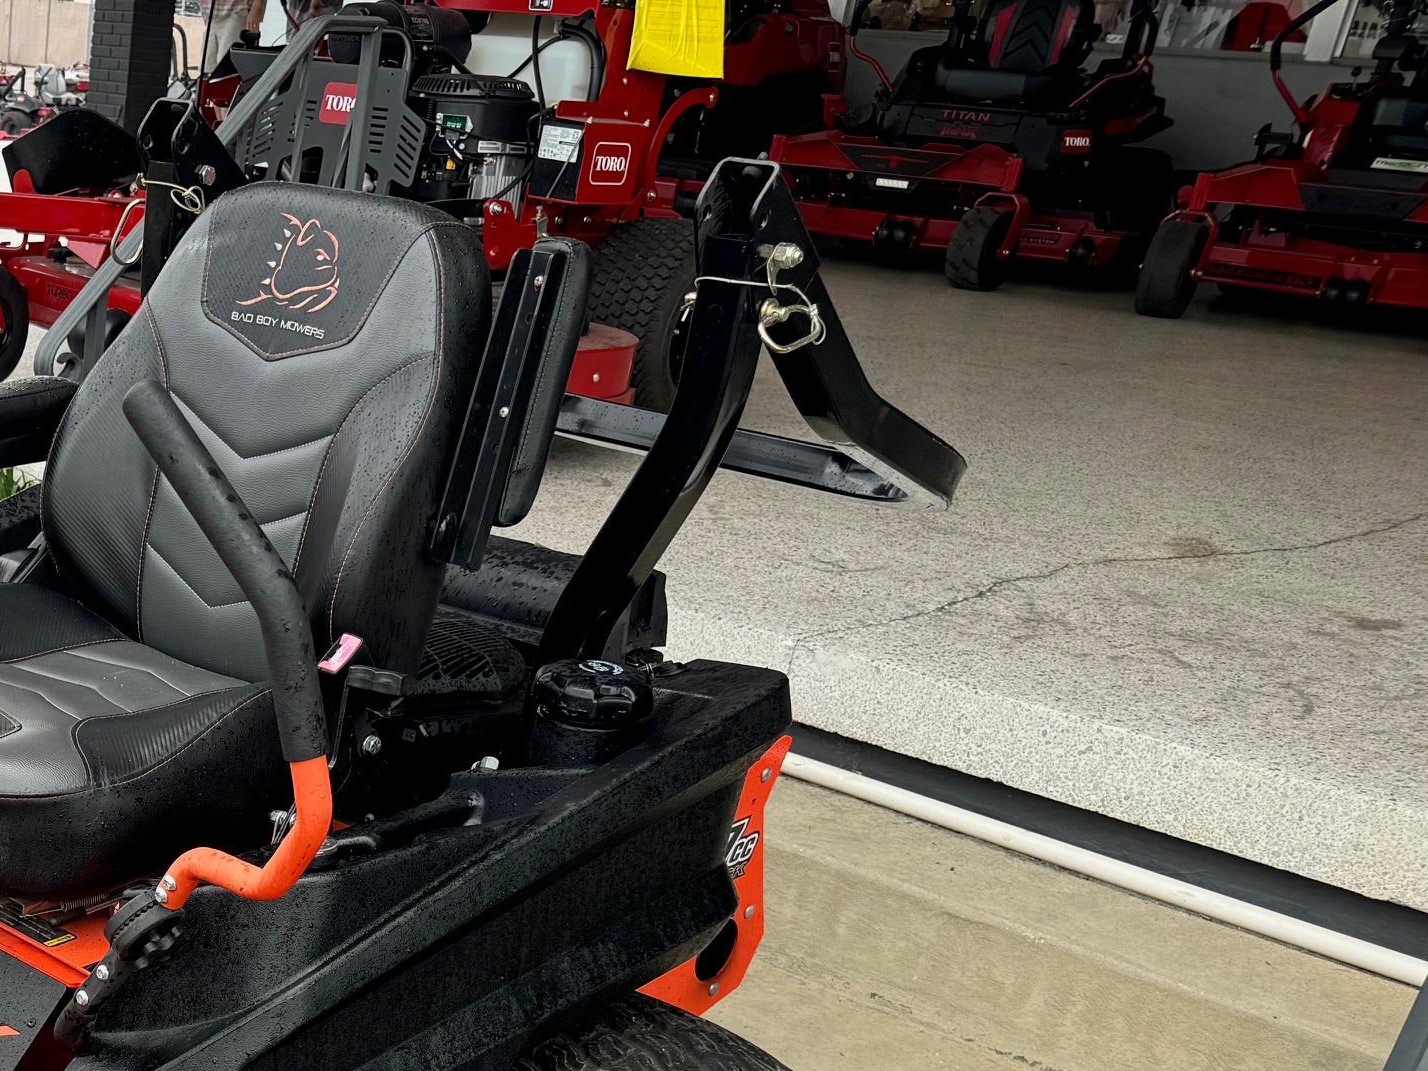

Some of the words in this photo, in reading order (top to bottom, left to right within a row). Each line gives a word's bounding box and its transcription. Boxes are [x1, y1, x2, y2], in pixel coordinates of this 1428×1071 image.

[942, 109, 991, 122] TITAN
[1064, 136, 1090, 147] TORO
[595, 156, 625, 172] TORO
[231, 311, 254, 323] BAD
[256, 315, 279, 327] BOY
[280, 319, 325, 340] MOWERS
